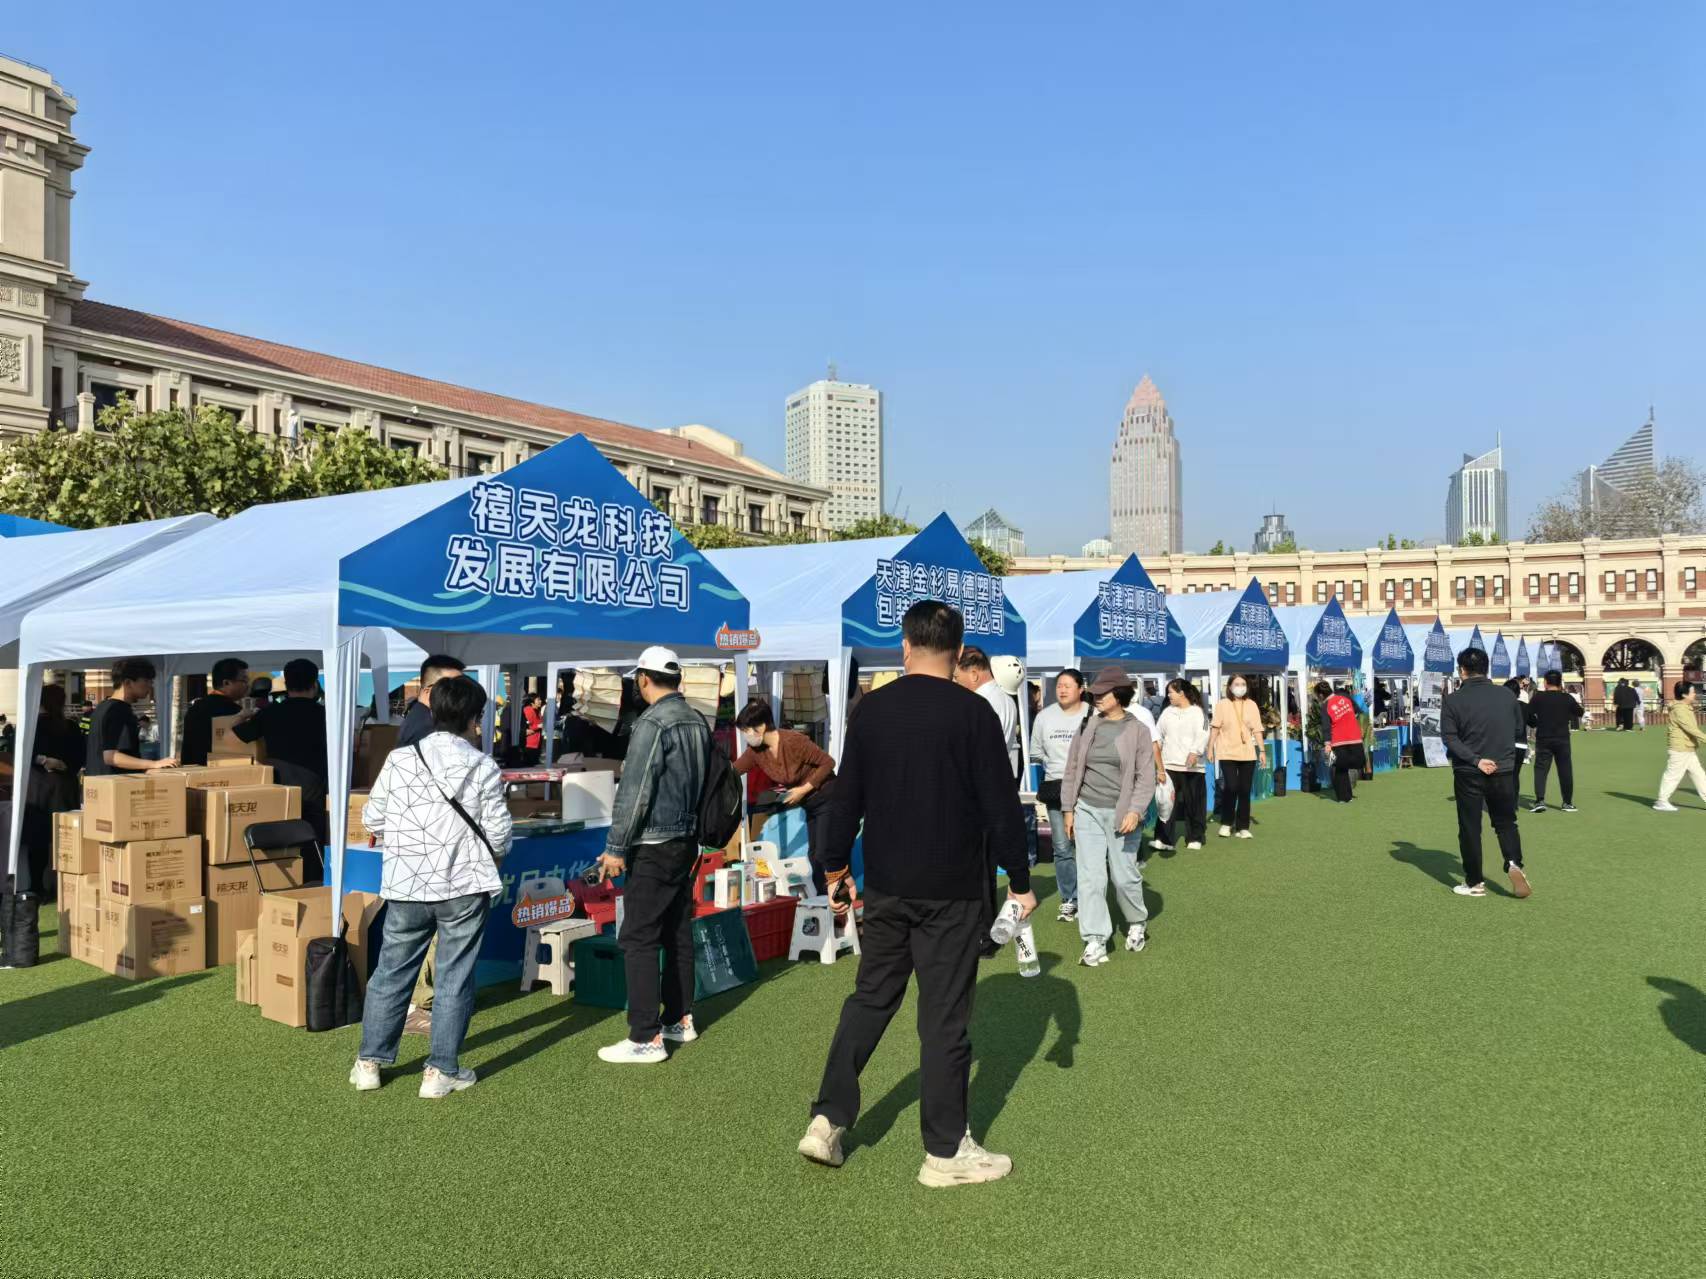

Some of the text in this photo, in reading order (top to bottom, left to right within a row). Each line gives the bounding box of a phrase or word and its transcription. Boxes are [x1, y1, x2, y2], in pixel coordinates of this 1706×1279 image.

[471, 481, 673, 559] 禧天龙科技
[446, 536, 689, 610] 发展有限公司
[876, 593, 1005, 636] 包装任公司
[1099, 609, 1168, 644] 包装有限公司
[517, 896, 571, 923] 热销爆品
